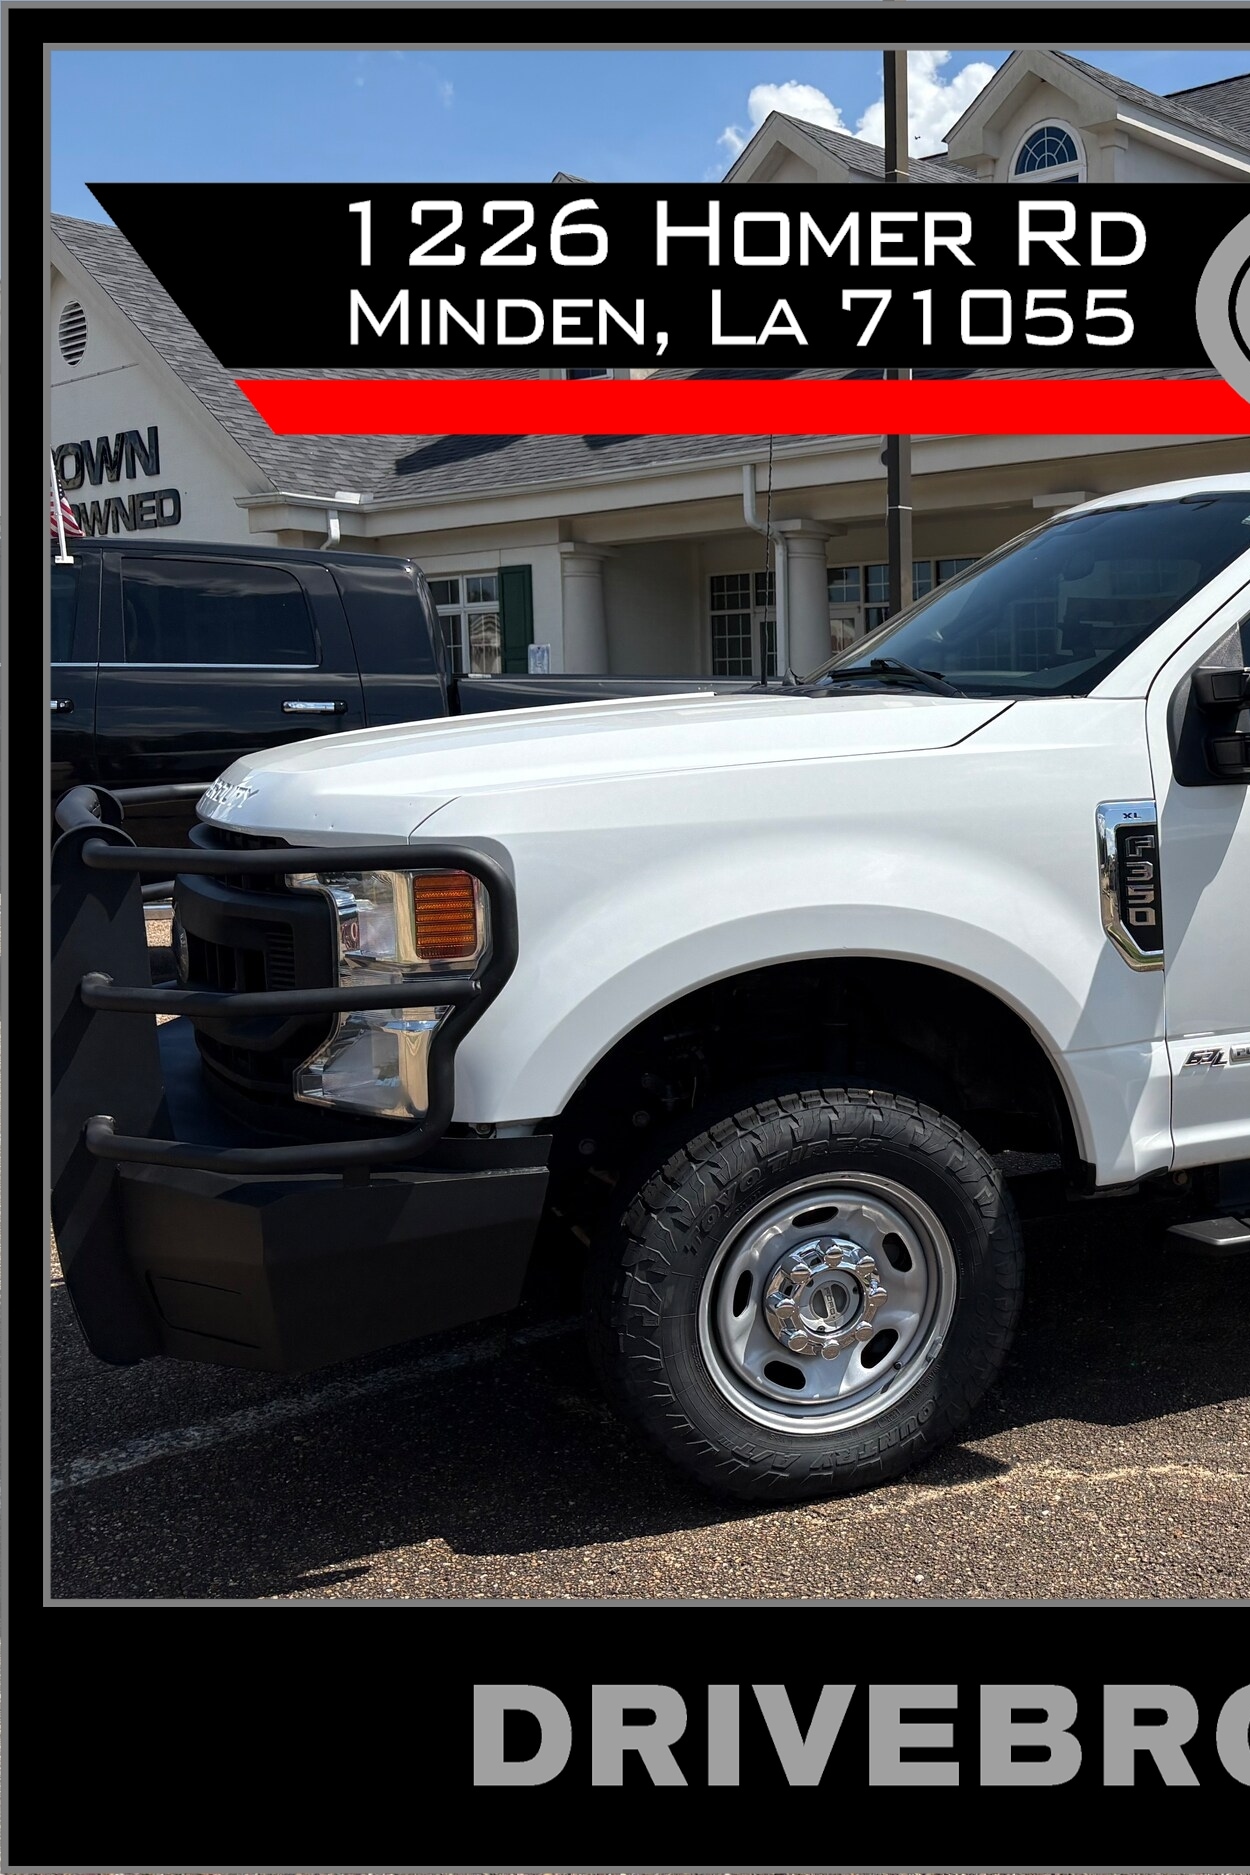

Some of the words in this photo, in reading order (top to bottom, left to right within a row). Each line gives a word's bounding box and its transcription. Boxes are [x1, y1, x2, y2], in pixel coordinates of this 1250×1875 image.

[50, 425, 161, 490] OWN
[1122, 811, 1142, 820] XL
[1125, 835, 1156, 926] F350
